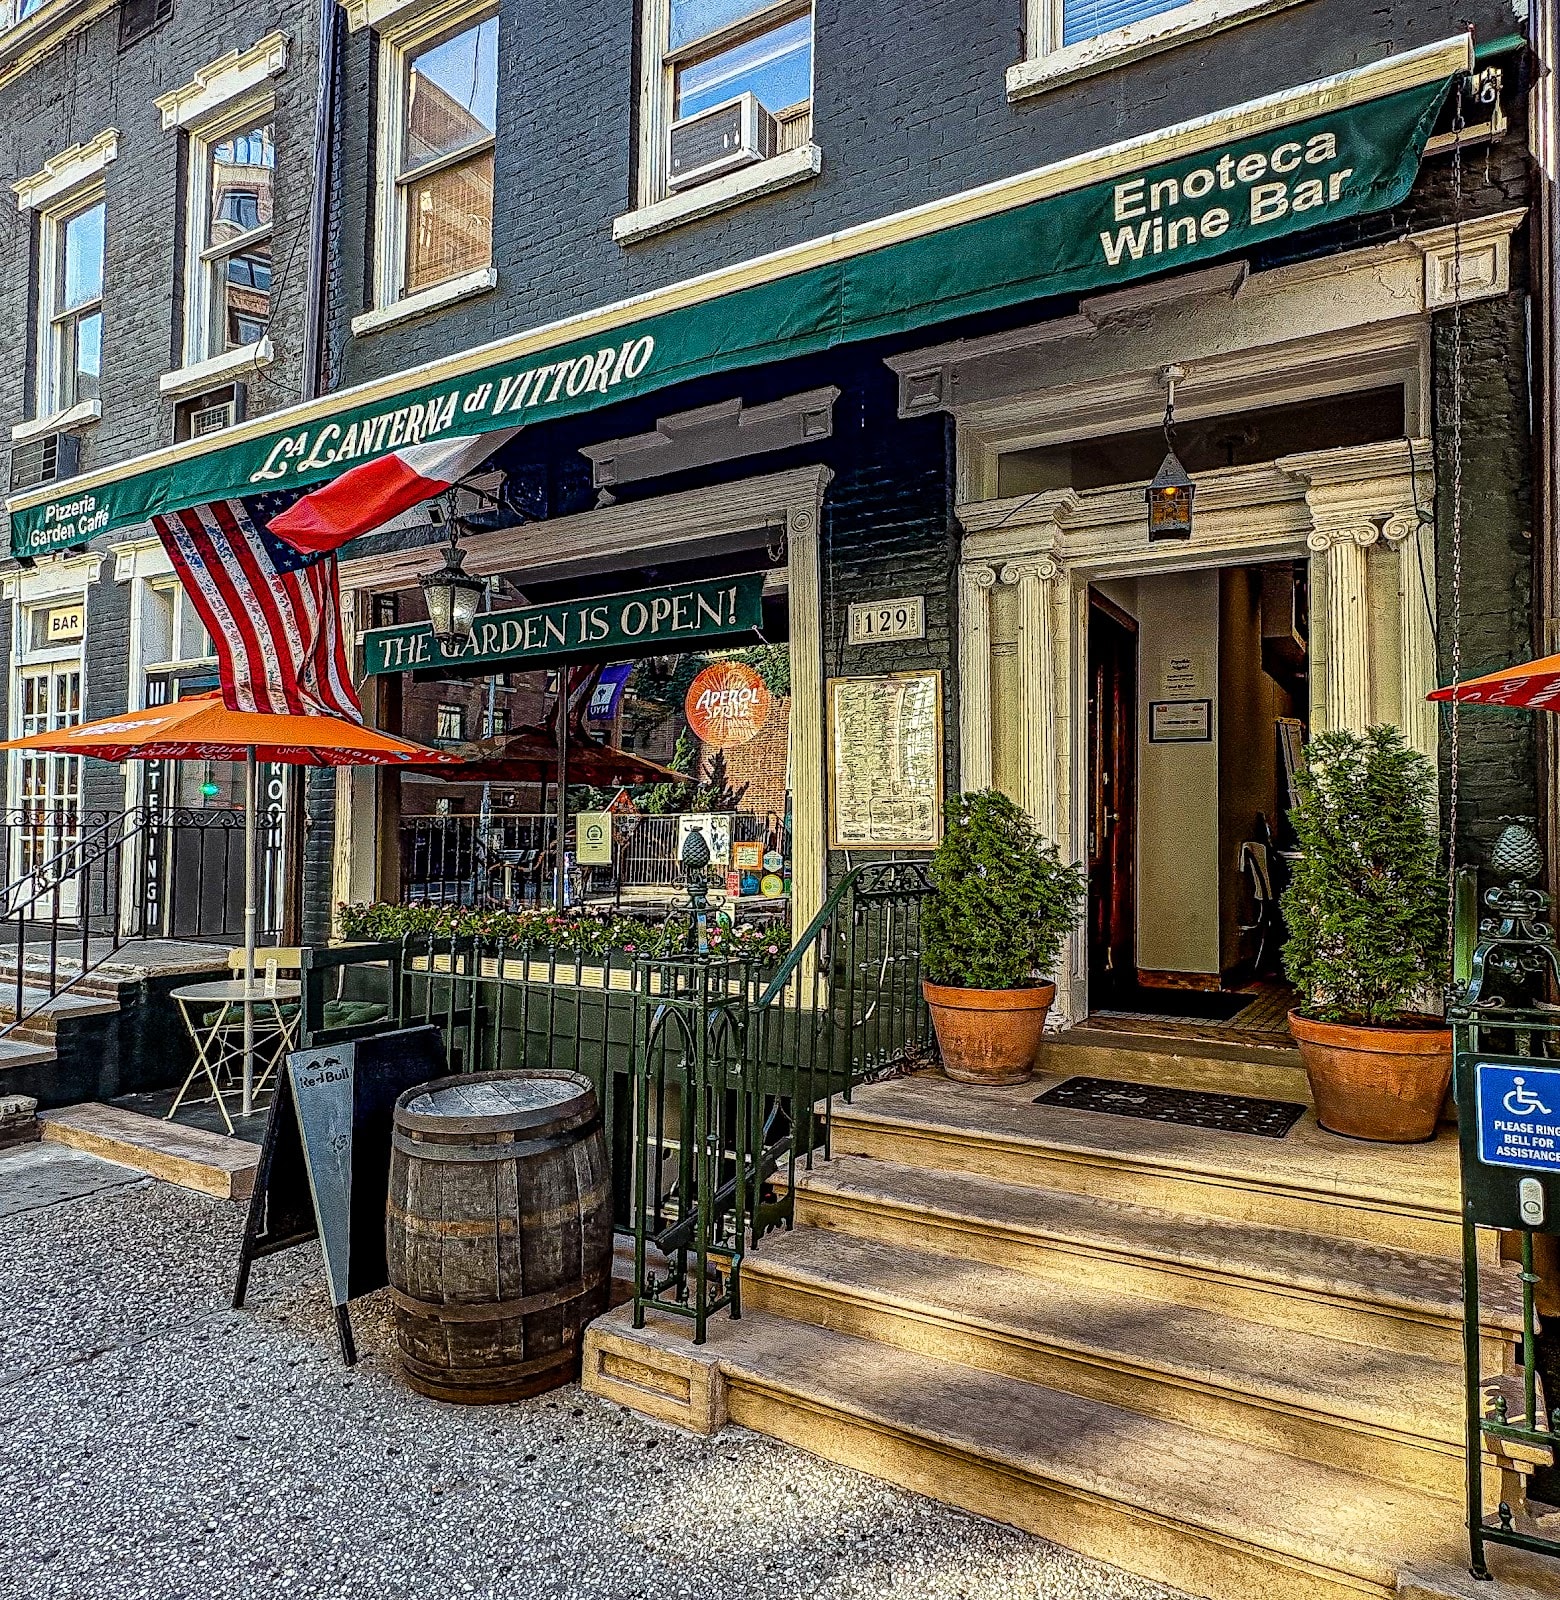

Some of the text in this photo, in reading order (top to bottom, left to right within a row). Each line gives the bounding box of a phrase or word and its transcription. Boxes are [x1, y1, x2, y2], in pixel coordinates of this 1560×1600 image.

[1114, 131, 1337, 222] Enoteca
[1100, 168, 1353, 266] Wine Bar
[250, 335, 655, 483] LA LANTERNA di VITTORIO
[45, 495, 96, 523] Pizzeria
[30, 504, 110, 547] Garden Caffé
[52, 614, 78, 632] BAR
[379, 631, 433, 668] THE
[578, 606, 611, 644] IS
[621, 587, 738, 636] OPEN!
[865, 609, 907, 633] 129
[695, 688, 760, 710] APEROL
[326, 1067, 350, 1083] Bull
[1494, 1120, 1560, 1137] PLEASE RING
[1504, 1133, 1554, 1148] BELL FOR
